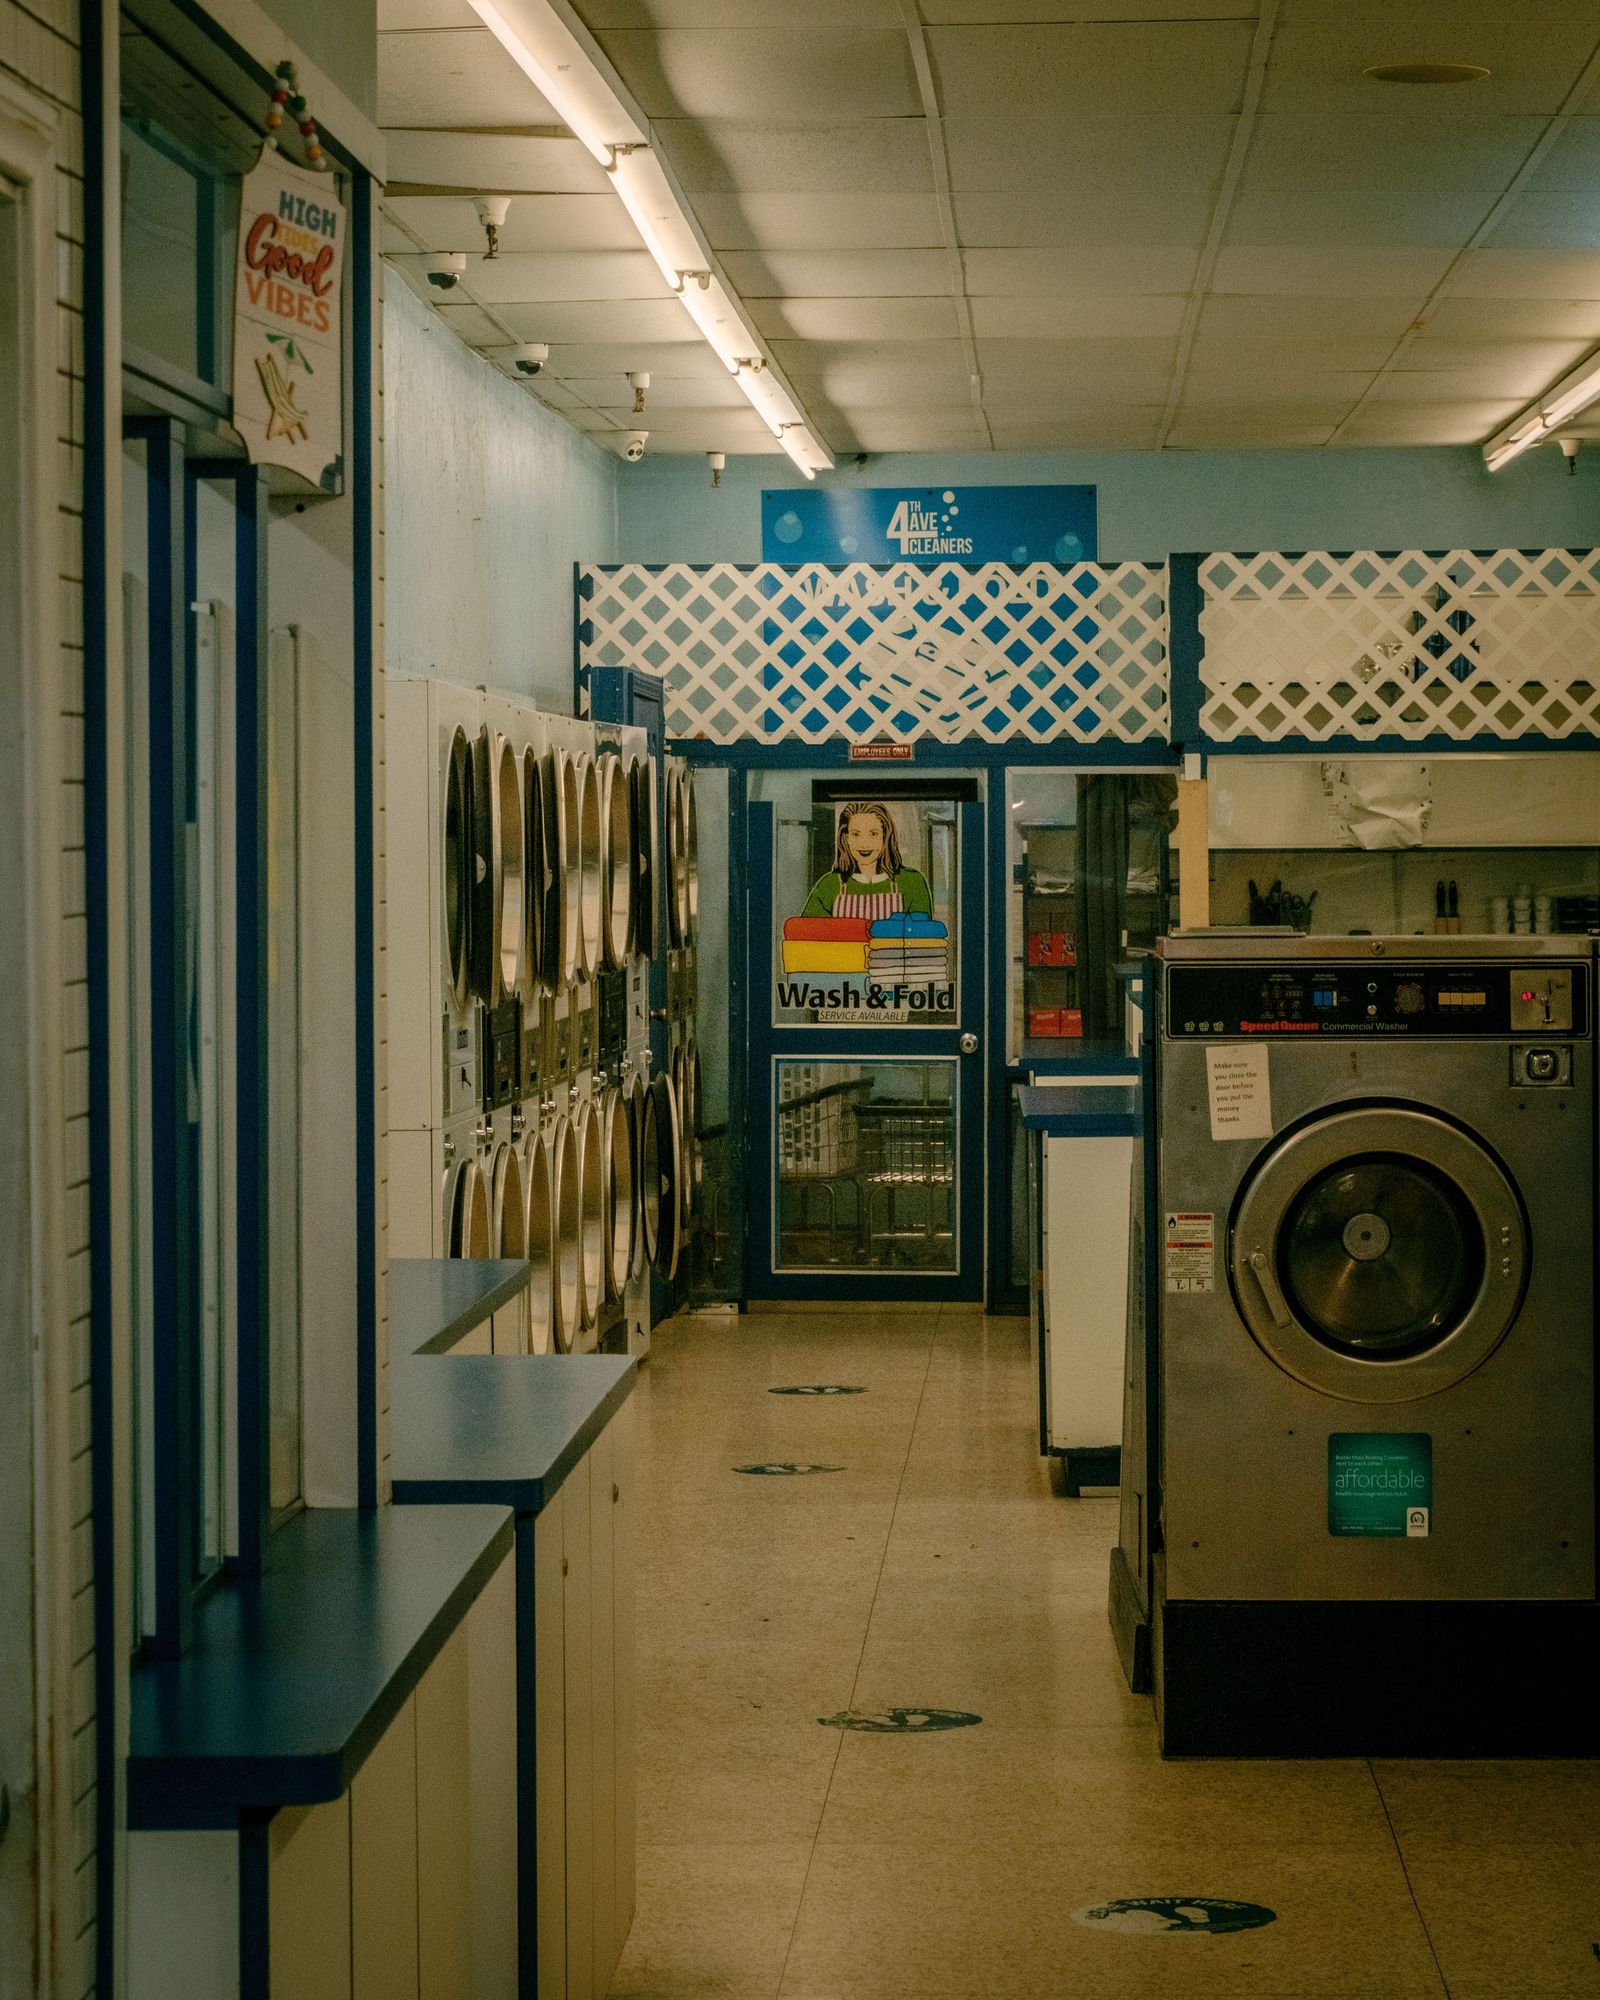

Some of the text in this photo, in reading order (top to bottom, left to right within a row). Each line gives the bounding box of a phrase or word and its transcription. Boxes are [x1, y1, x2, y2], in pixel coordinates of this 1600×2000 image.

[278, 190, 337, 239] HIGH
[245, 212, 334, 297] Good
[244, 270, 331, 333] VIBES
[909, 512, 938, 531] AVE
[909, 538, 973, 555] CLEANERS
[853, 747, 909, 757] EMPLOYEES ONLY
[777, 981, 955, 1010] Wash & Fold
[819, 1011, 907, 1021] SERVICE AVAILABLE
[1240, 1021, 1279, 1033] Speed
[1322, 1022, 1373, 1031] Commercial
[1376, 1022, 1408, 1031] Washer
[1232, 1082, 1253, 1090] before
[1336, 1468, 1425, 1488] affordable
